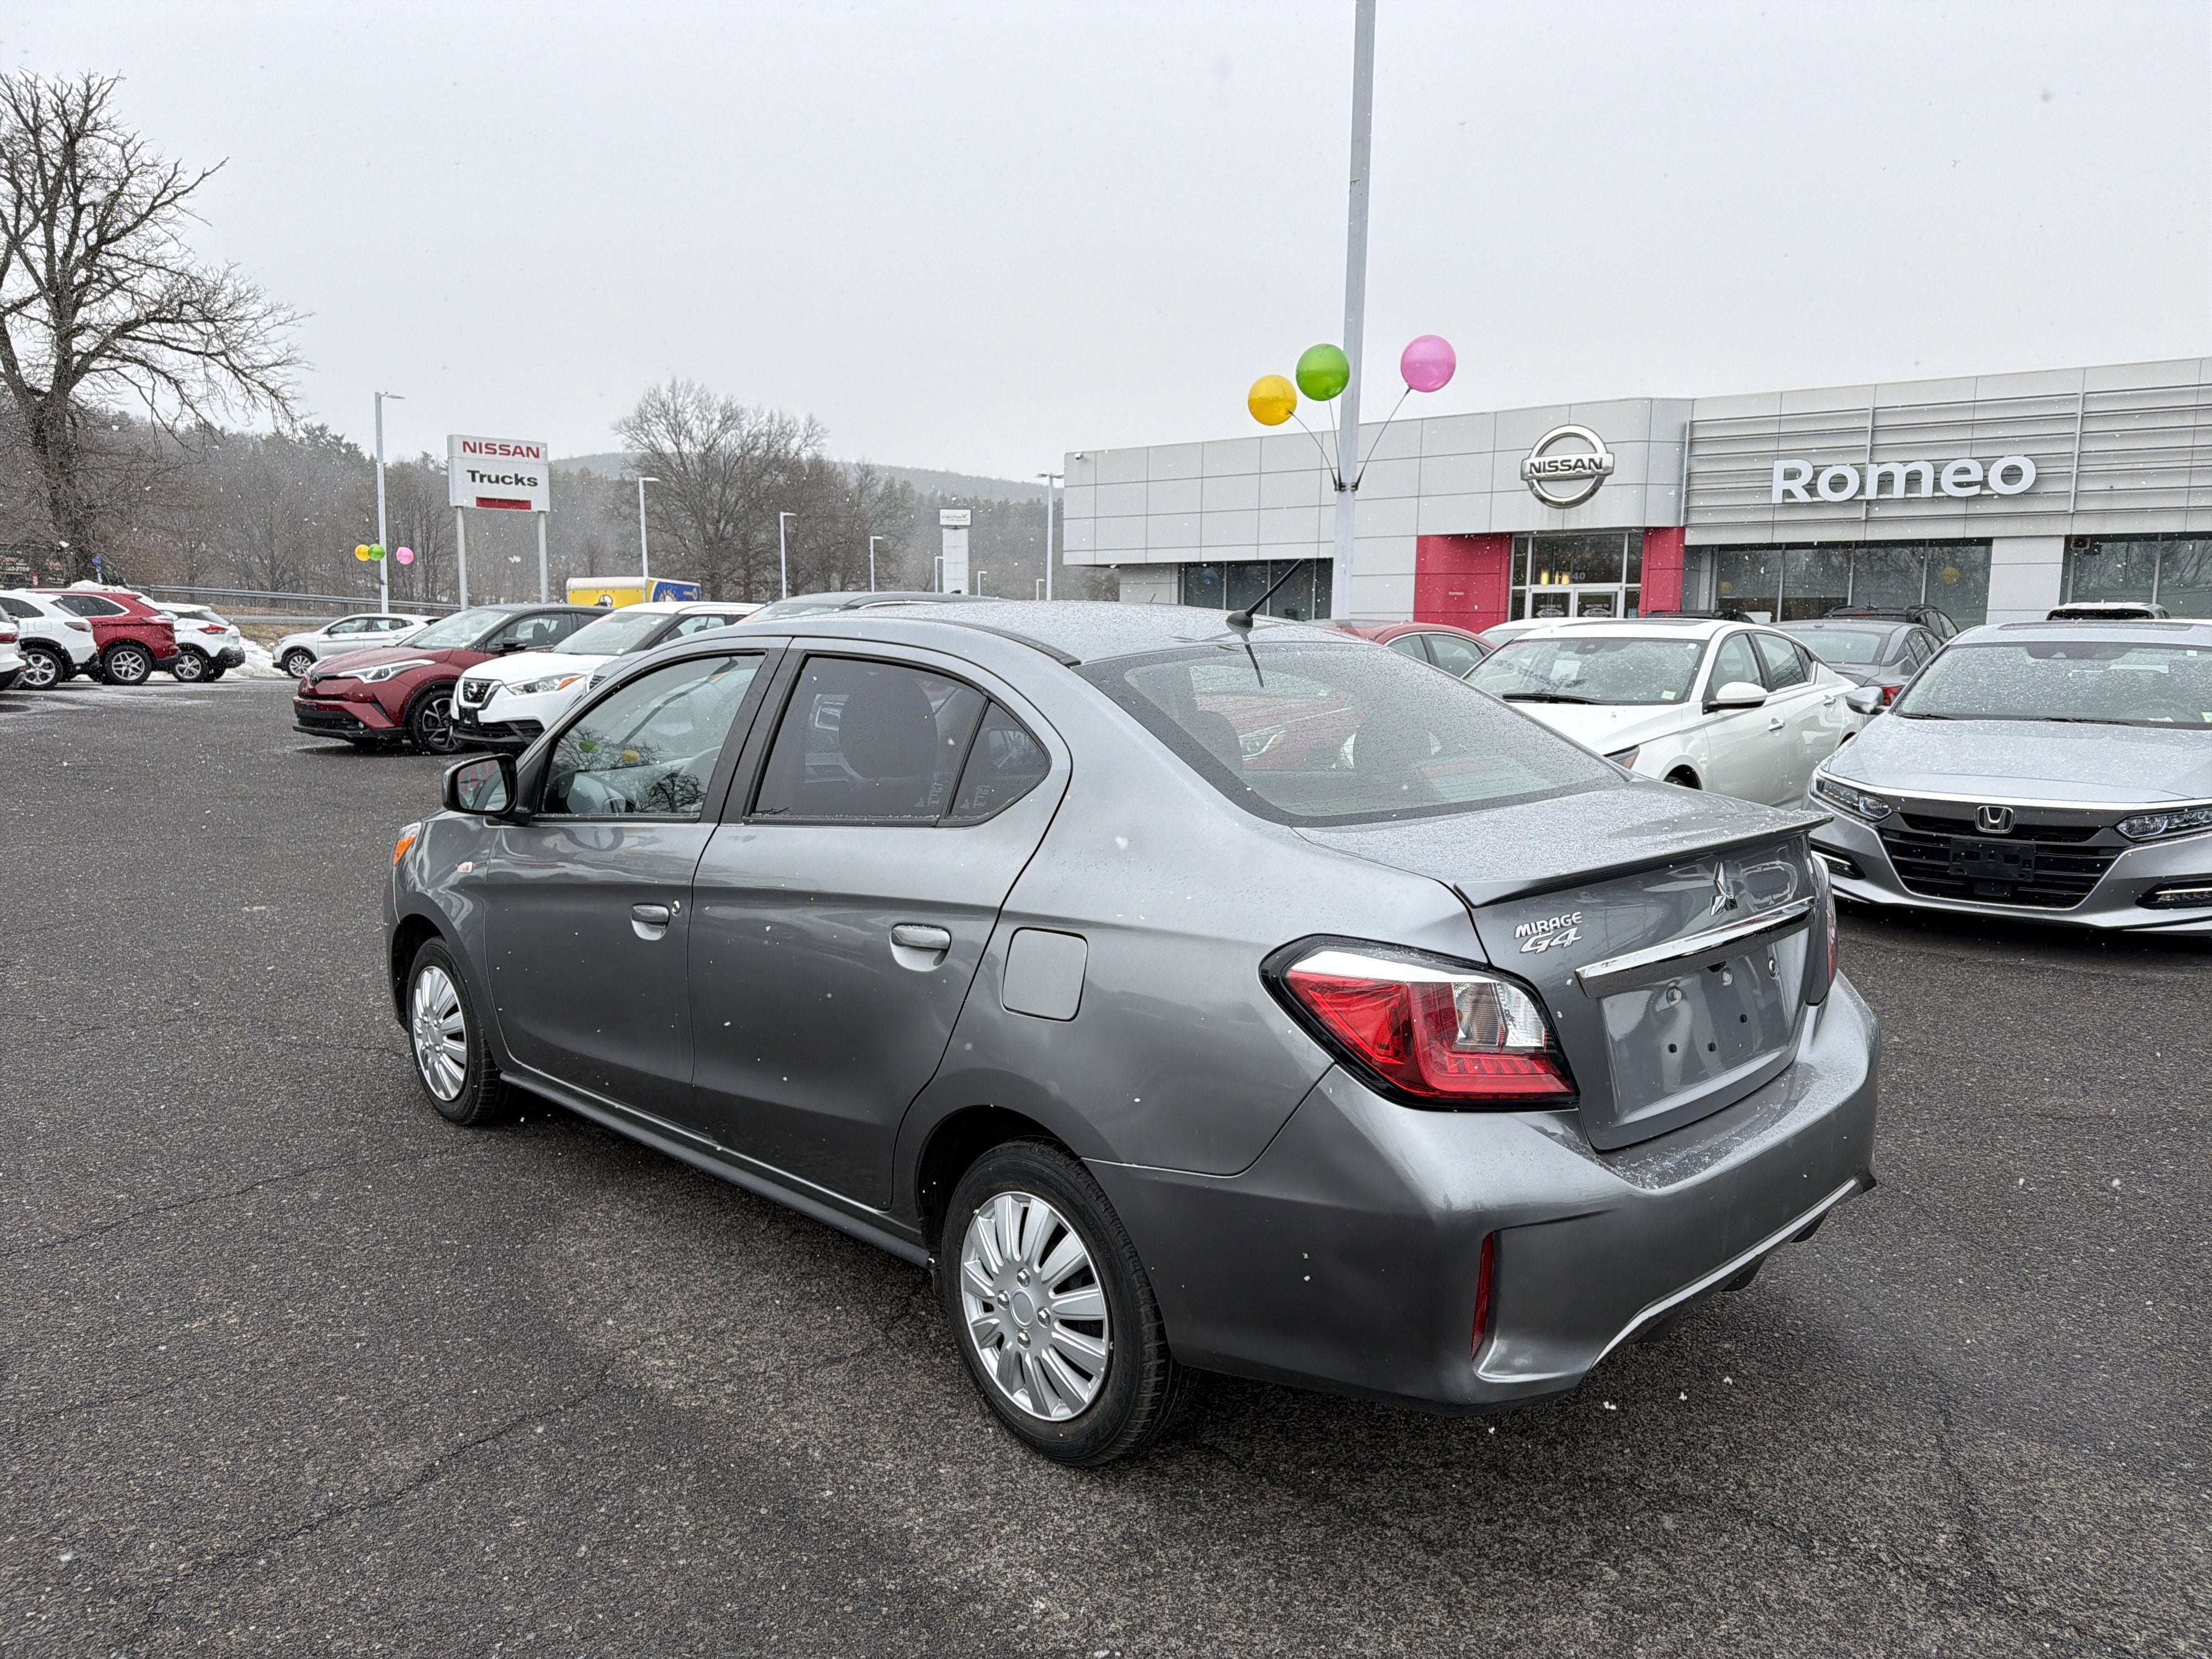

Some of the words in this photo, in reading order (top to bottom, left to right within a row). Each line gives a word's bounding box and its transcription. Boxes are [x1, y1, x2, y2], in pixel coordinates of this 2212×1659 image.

[462, 441, 540, 459] NISSAN
[1529, 457, 1603, 475] NISSAN
[466, 469, 538, 487] Trucks
[1771, 455, 2036, 504] Romeo
[1515, 911, 1583, 939] MIRAGE
[1520, 927, 1584, 953] G4
